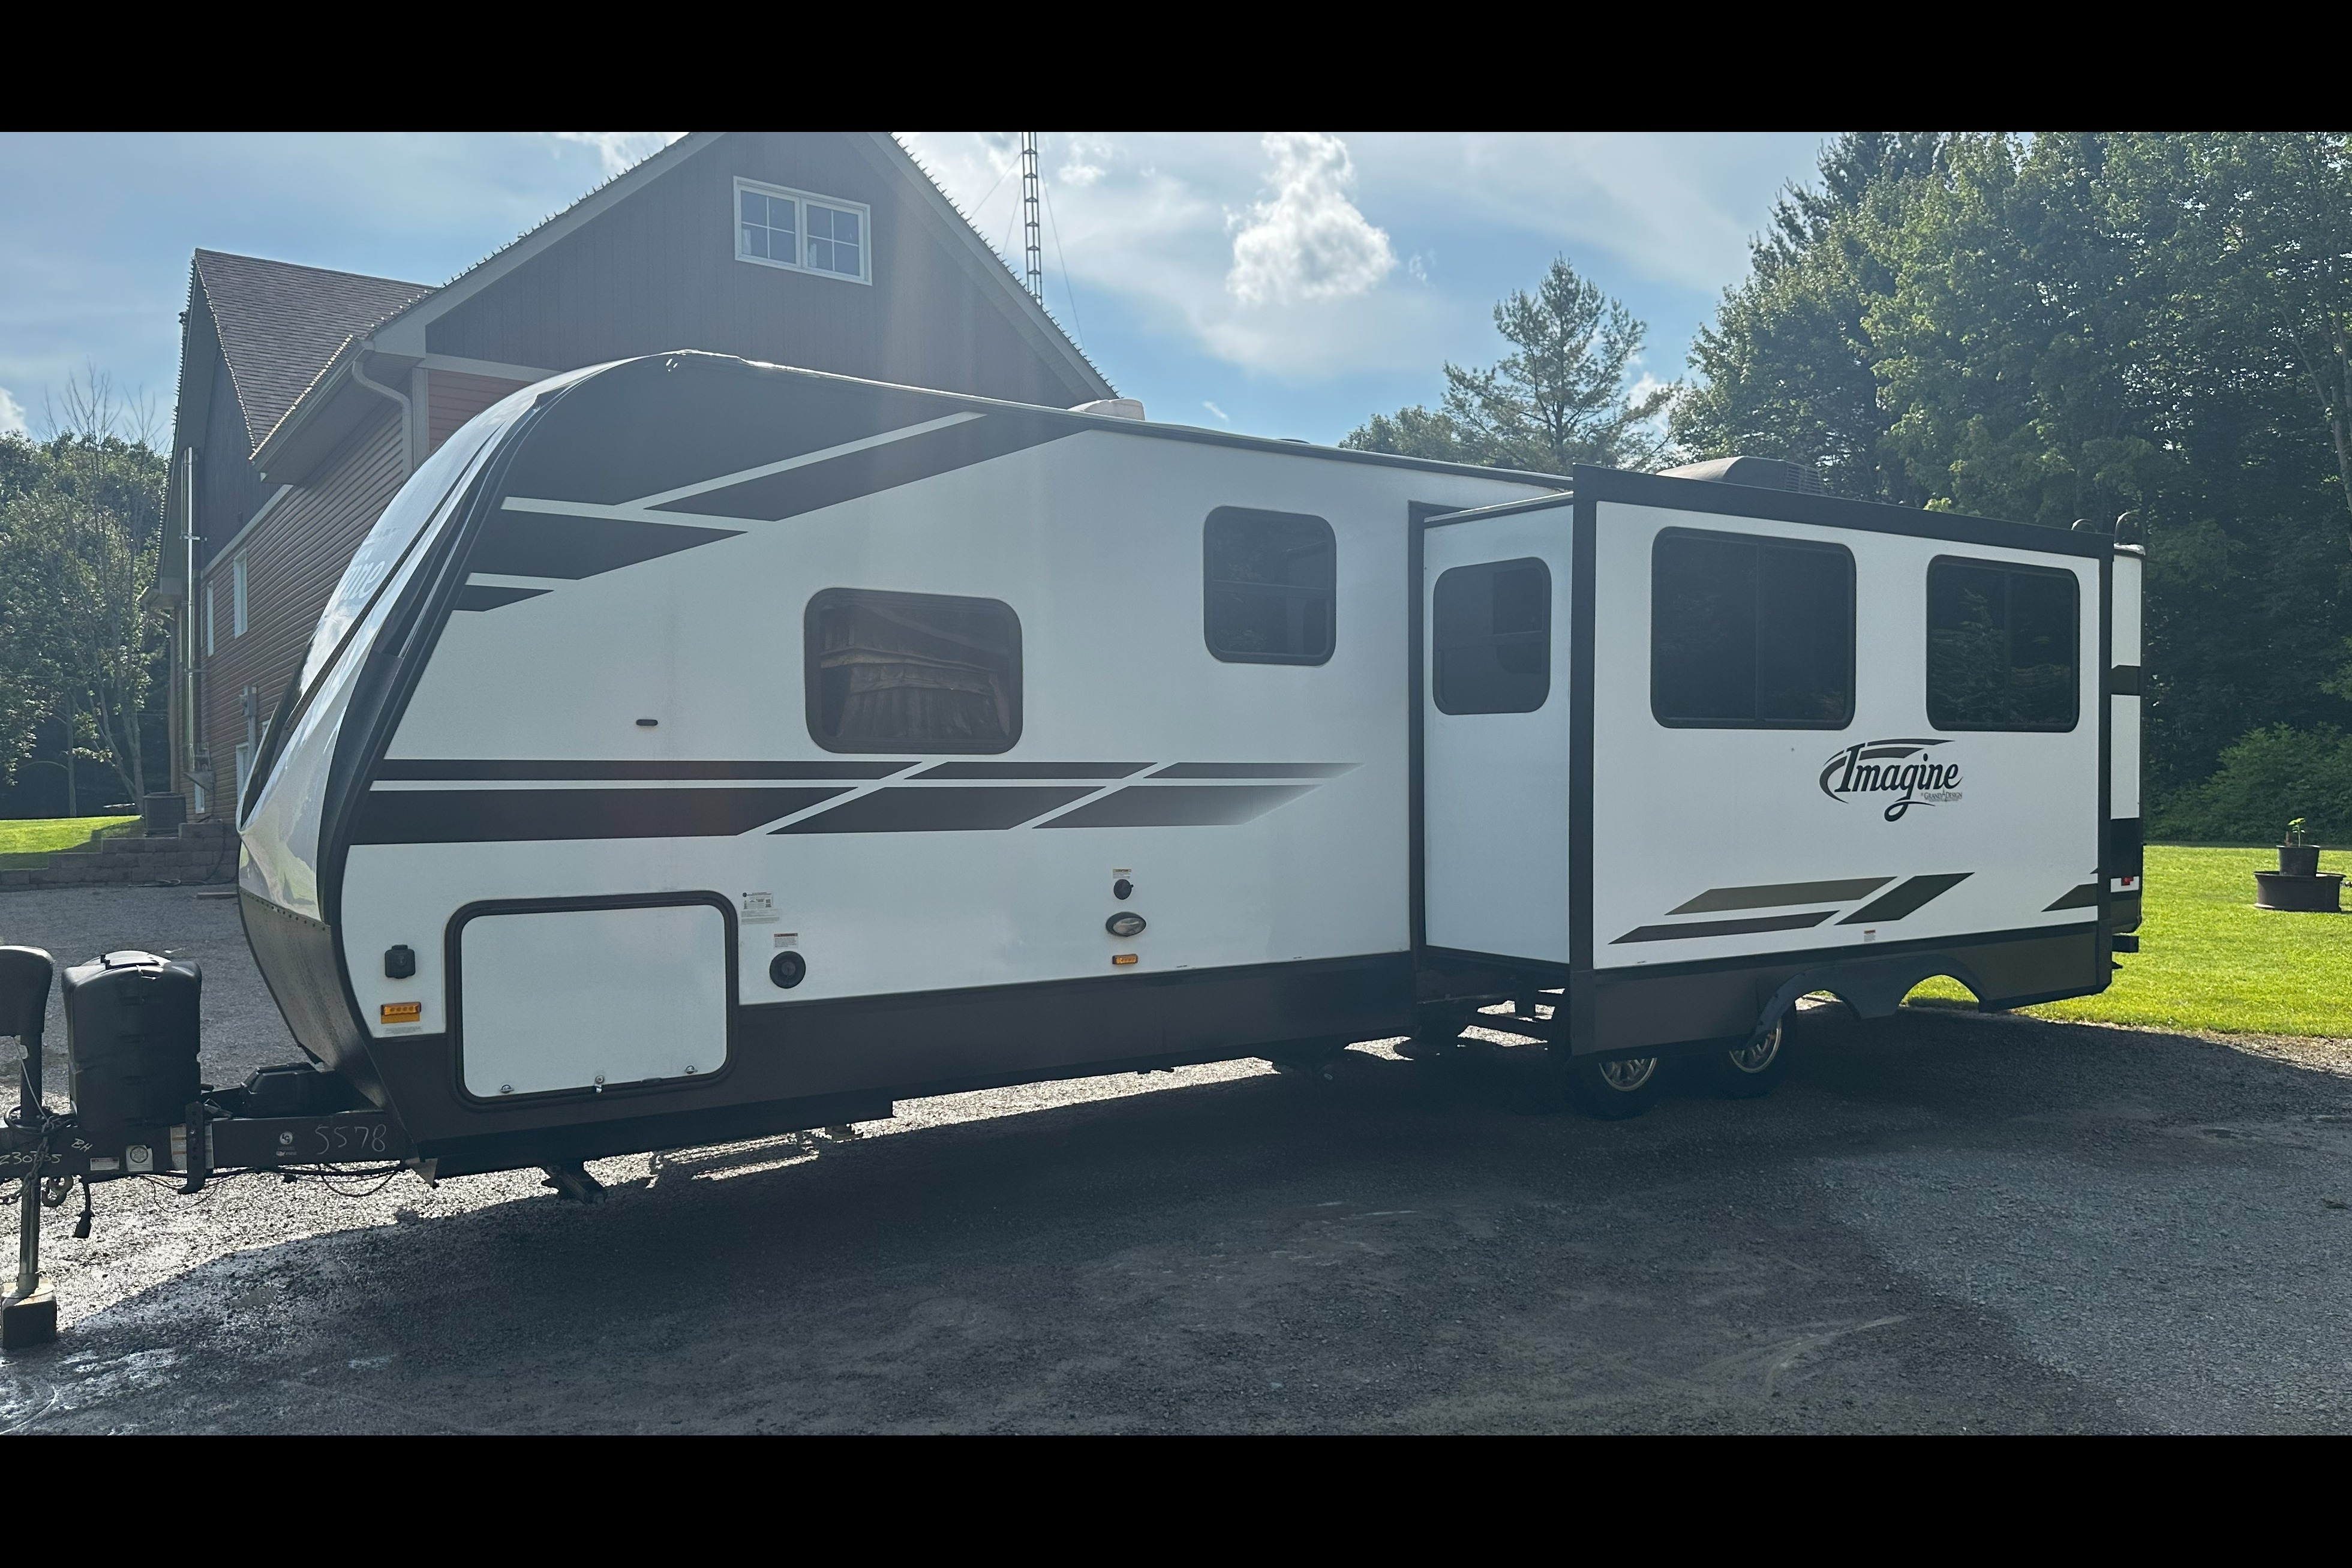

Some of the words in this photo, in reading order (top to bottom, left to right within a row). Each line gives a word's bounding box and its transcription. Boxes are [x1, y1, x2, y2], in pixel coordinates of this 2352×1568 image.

[1834, 742, 1963, 822] Imagine
[71, 1138, 93, 1152] BH
[315, 1124, 387, 1155] 5578
